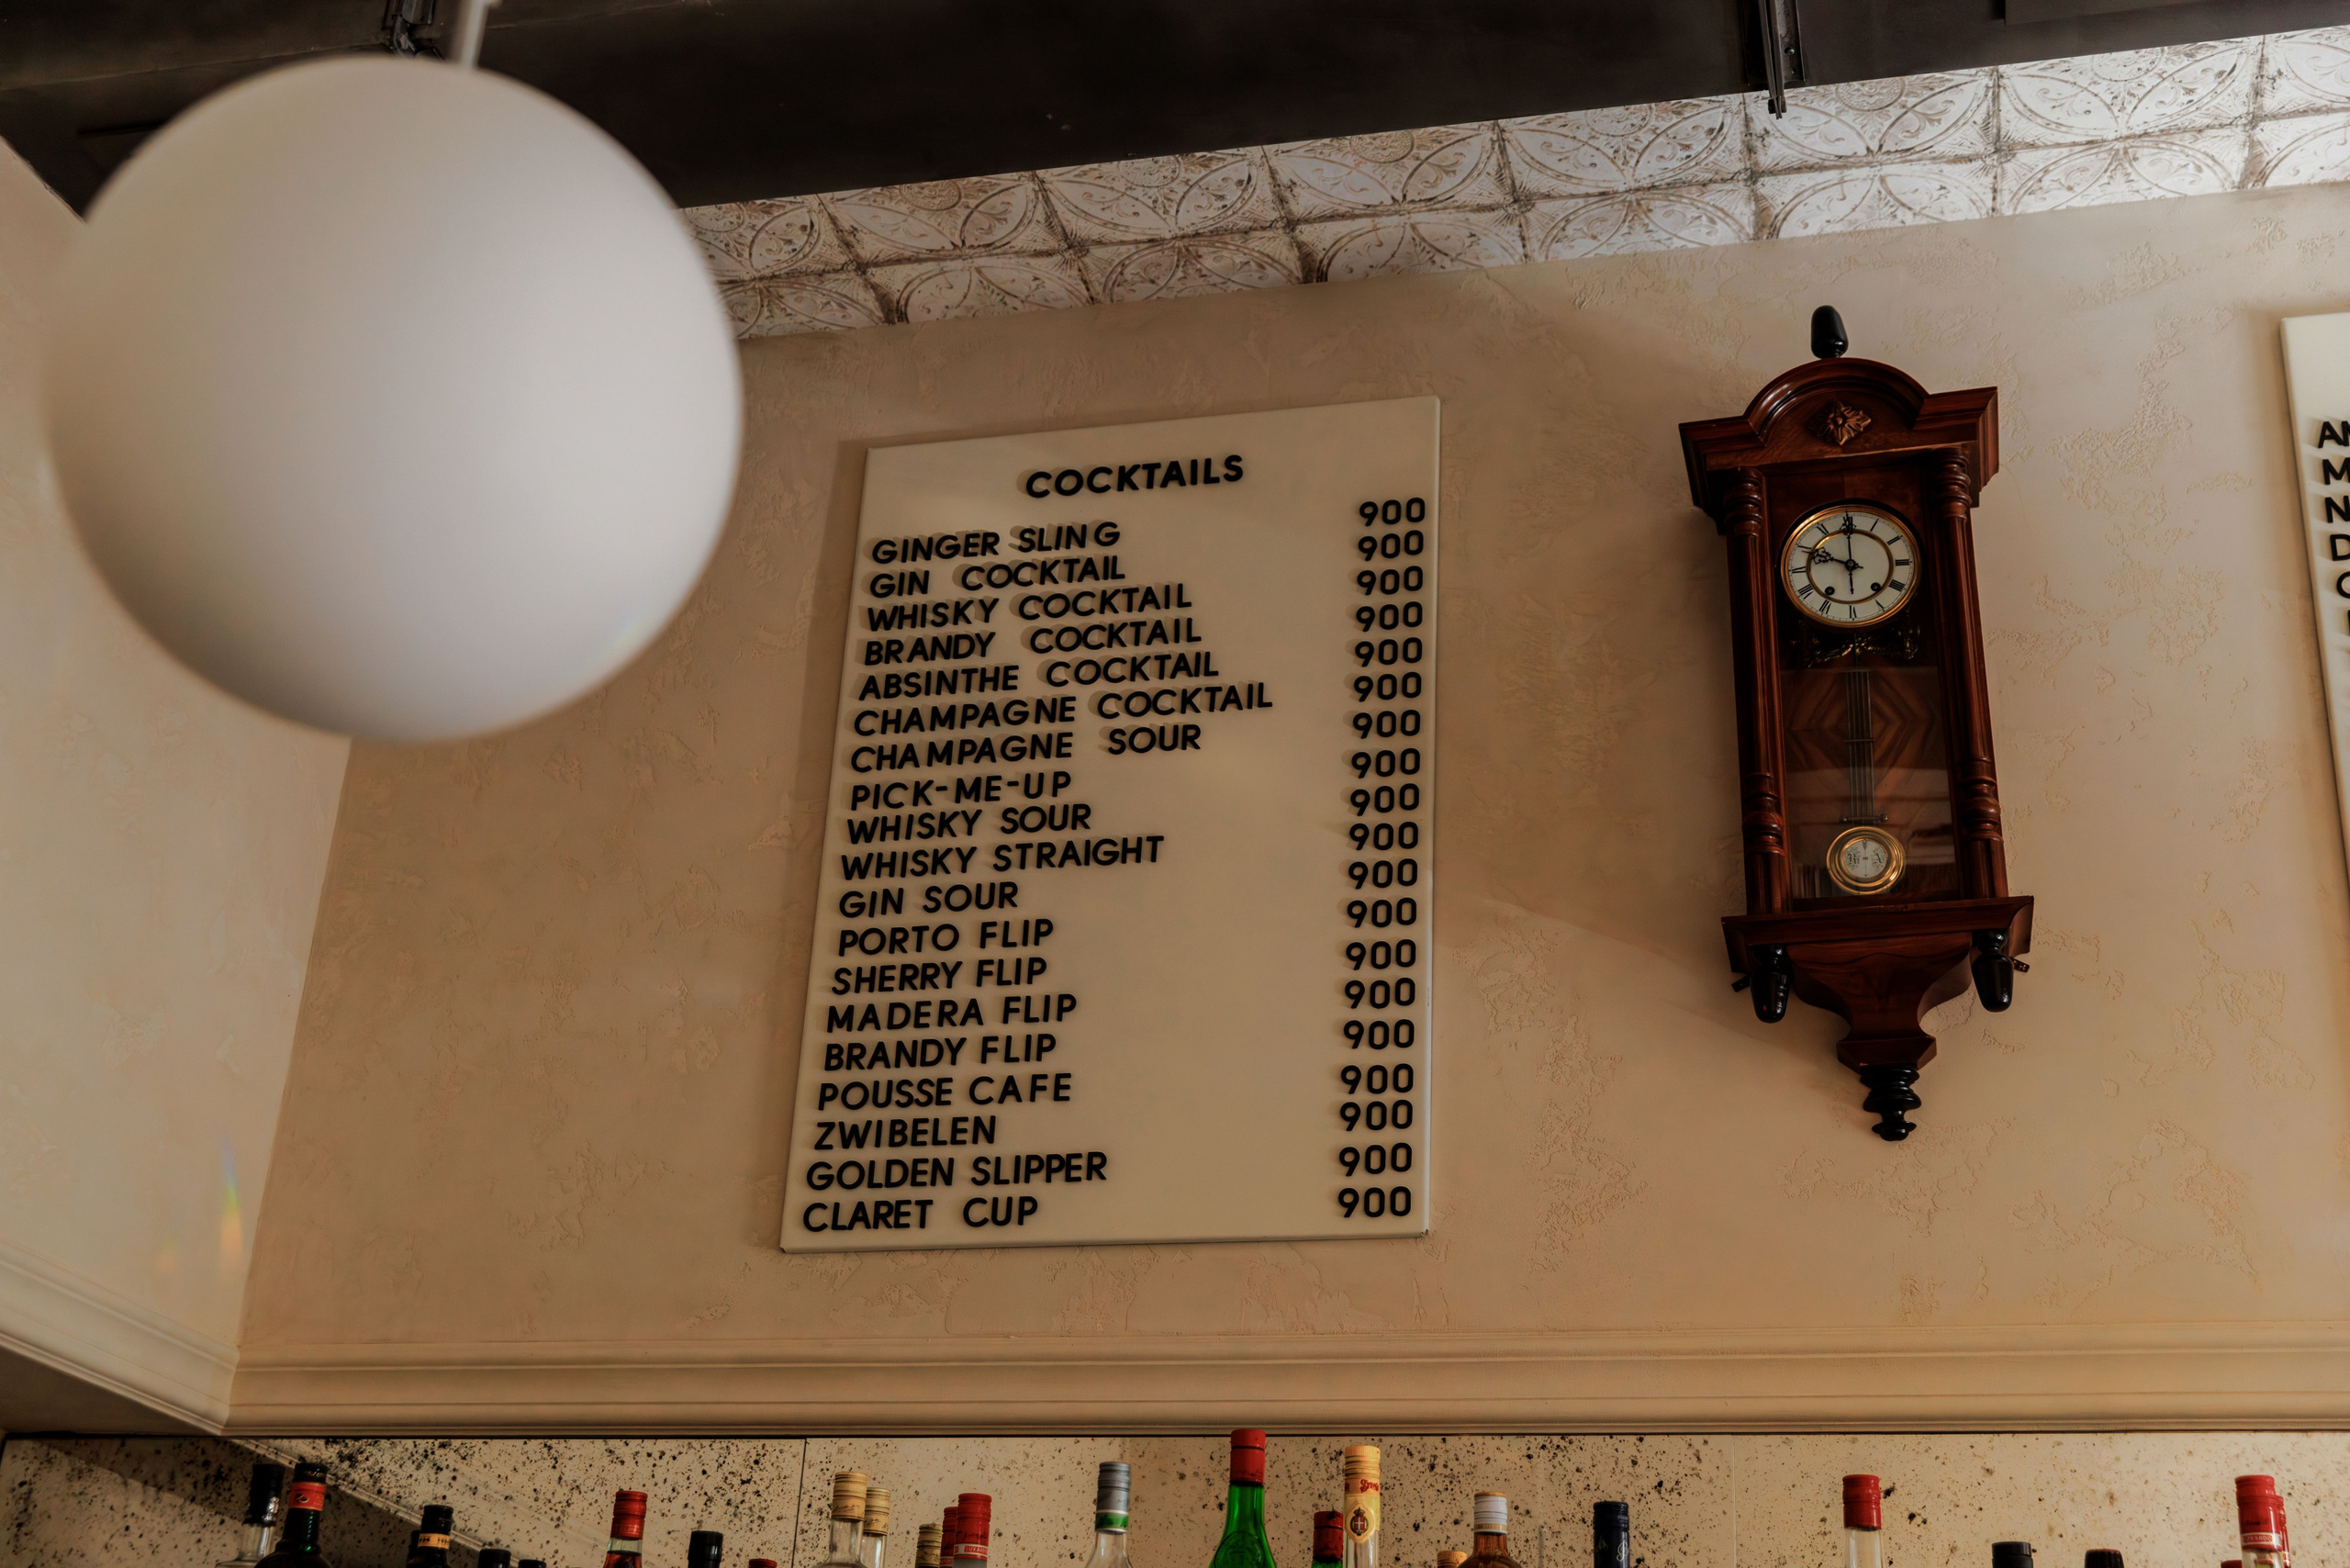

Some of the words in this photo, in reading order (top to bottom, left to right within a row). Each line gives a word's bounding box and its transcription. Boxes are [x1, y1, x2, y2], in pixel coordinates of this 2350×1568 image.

[1025, 454, 1244, 498] COCKTAILS
[1359, 497, 1426, 527] 900
[871, 532, 1000, 565] GINGER
[1017, 521, 1121, 554] SLING
[1358, 530, 1424, 562] 900
[869, 570, 930, 599] GIN
[961, 554, 1125, 591] COCKTAIL
[1357, 566, 1424, 596] 900
[867, 598, 1000, 632] WHISKY
[1018, 583, 1192, 621] COCKTAIL
[1355, 601, 1423, 633] 900
[864, 632, 996, 666] BRANDY
[1029, 617, 1202, 655] COCKTAIL
[1354, 636, 1423, 667] 900
[858, 665, 1020, 701] ABSINTHE
[1046, 651, 1219, 688] COCKTAIL
[1353, 671, 1422, 702] 900
[854, 696, 1077, 737] CHAMPAGNE
[1097, 682, 1273, 720] COCKTAIL
[1352, 709, 1421, 740] 900
[850, 732, 1073, 773] CHAMPAGNE
[1107, 723, 1202, 756] SOUR
[1351, 747, 1421, 779] 900
[850, 770, 1071, 812] PICK-ME-UP
[1349, 783, 1420, 817] 900
[846, 809, 983, 845] WHISKY
[1000, 803, 1091, 834] SOUR
[1348, 821, 1419, 851] 900
[841, 846, 978, 881] WHISKY
[992, 835, 1165, 872] STRAIGHT
[1348, 858, 1418, 890] 900
[839, 887, 904, 919] GIN
[922, 881, 1018, 913] SOUR
[1347, 897, 1417, 928] 900
[838, 923, 960, 958] PORTO
[979, 918, 1054, 949] FLIP
[1345, 938, 1416, 971] 900
[831, 960, 963, 996] SHERRY
[976, 957, 1047, 988] FLIP
[1344, 977, 1416, 1010] 900
[826, 998, 984, 1034] MADERA
[1002, 993, 1077, 1025] FLIP
[824, 1036, 968, 1071] BRANDY
[980, 1033, 1057, 1064] FLIP
[1343, 1018, 1415, 1050] 900
[818, 1077, 954, 1111] POUSSE
[968, 1072, 1072, 1105] CAFE
[1340, 1063, 1414, 1095] 900
[813, 1114, 996, 1150] ZWIBELEN
[1339, 1099, 1414, 1132] 900
[806, 1157, 955, 1191] GOLDEN
[970, 1151, 1107, 1186] SLIPPER
[1338, 1142, 1413, 1177] 900
[802, 1199, 934, 1233] CLARET
[962, 1195, 1038, 1228] CUP
[1337, 1186, 1412, 1218] 900
